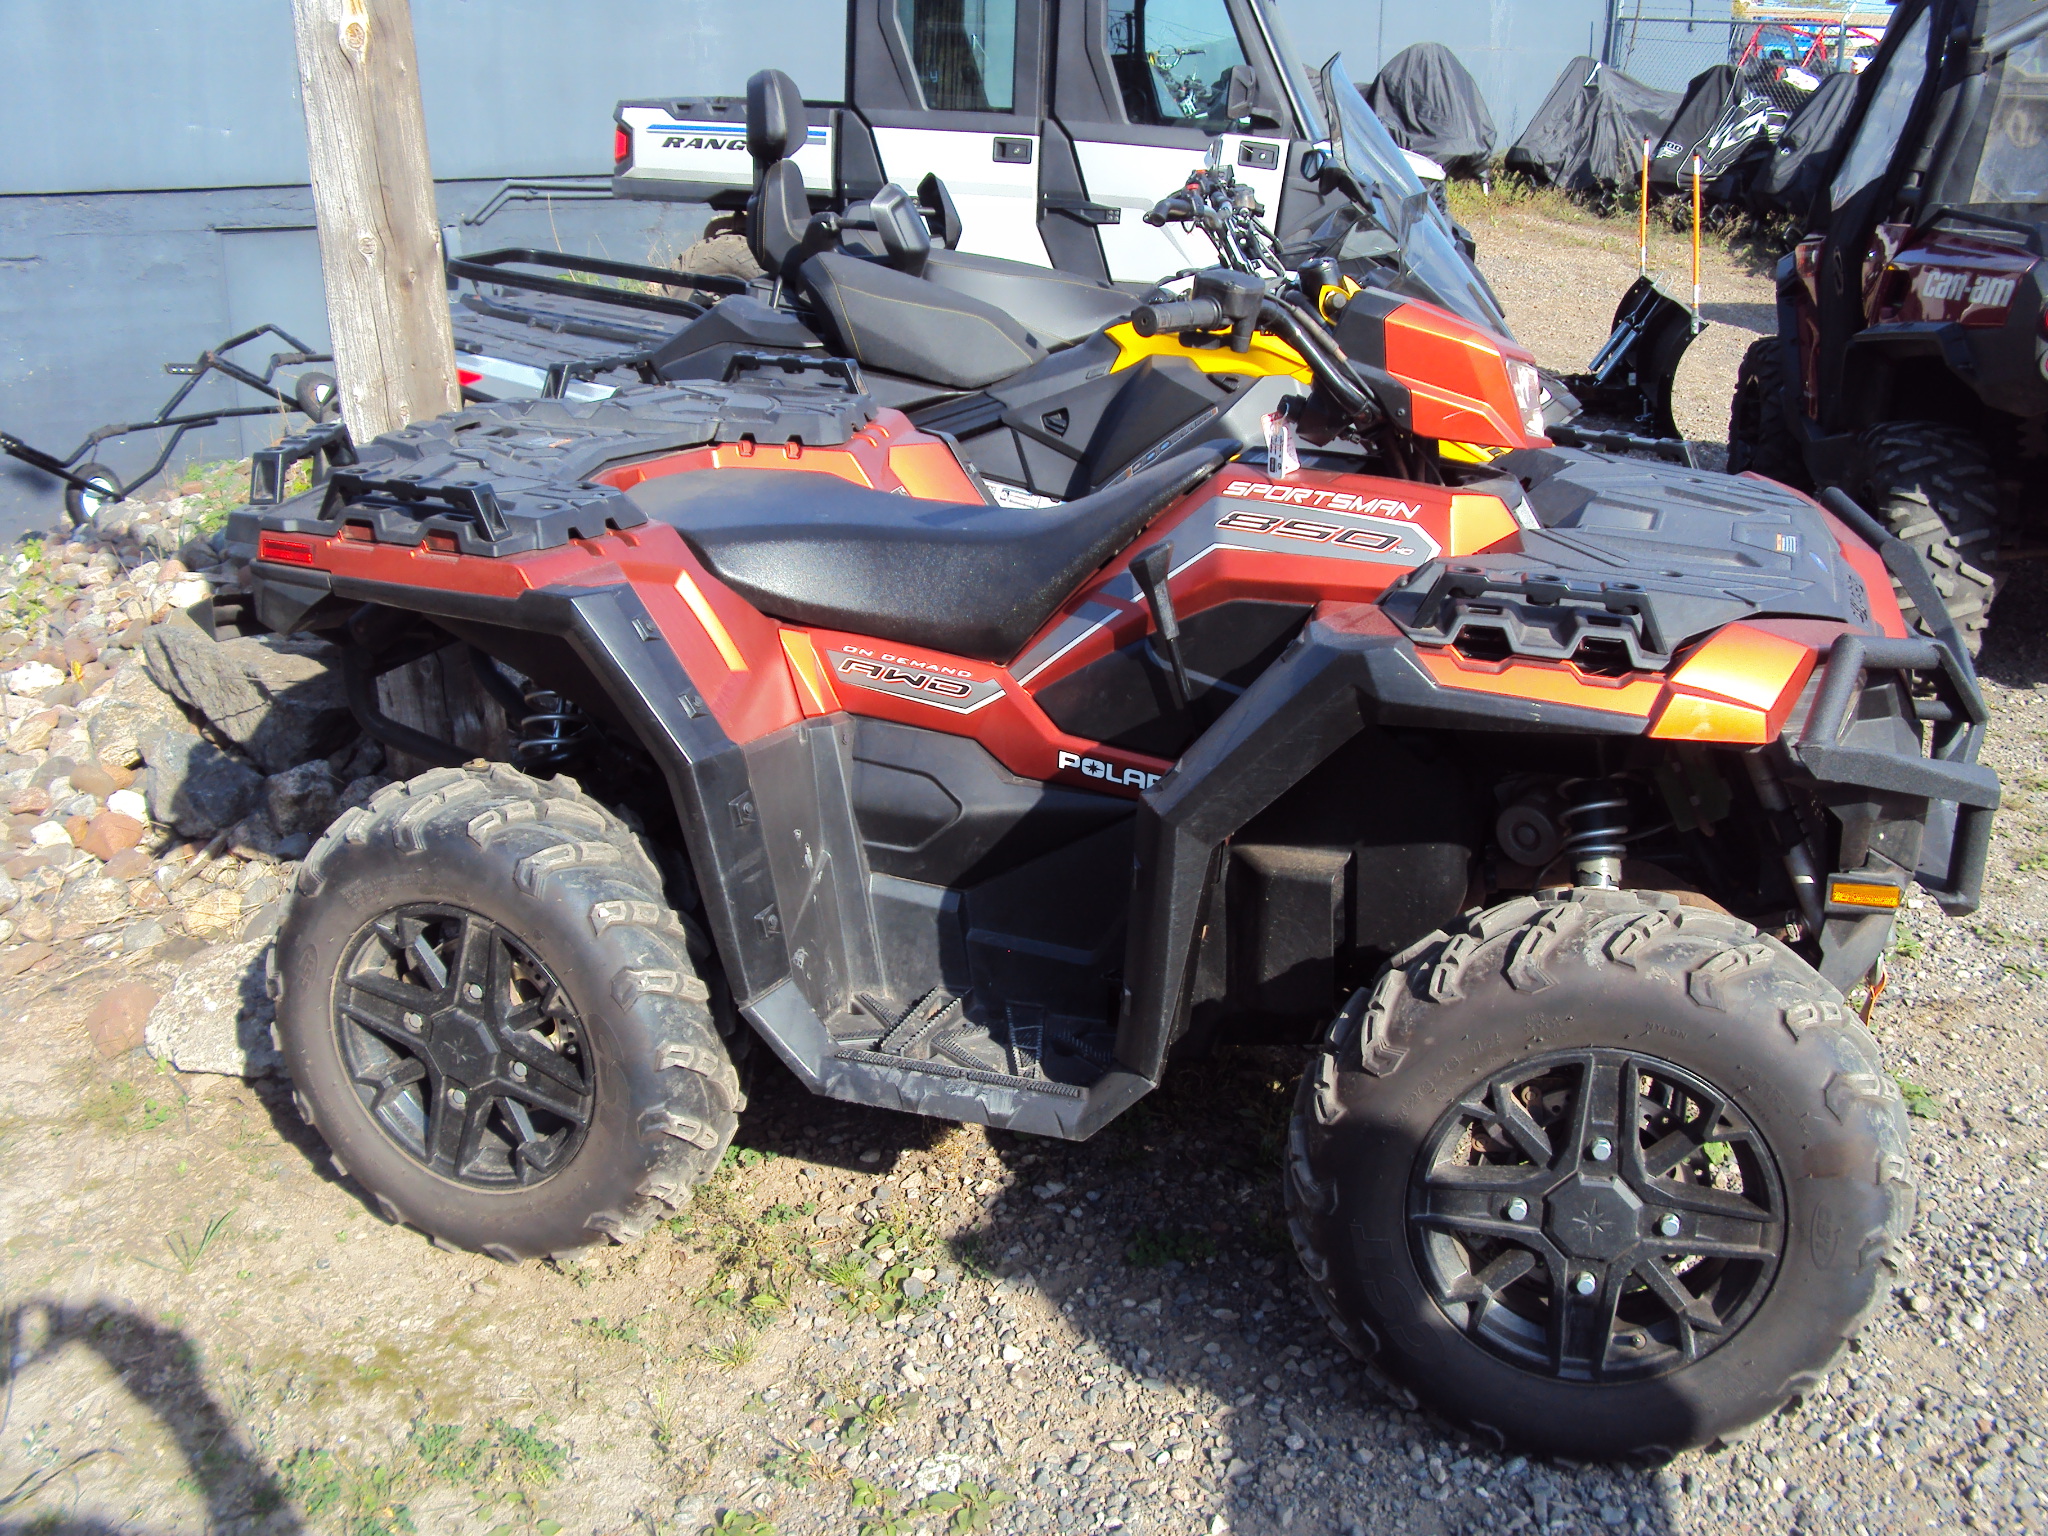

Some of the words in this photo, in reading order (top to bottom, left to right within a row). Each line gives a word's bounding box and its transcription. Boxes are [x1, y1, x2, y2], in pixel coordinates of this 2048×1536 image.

[1222, 480, 1422, 520] SPORTSMAN
[1214, 510, 1402, 552] 850
[837, 657, 973, 698] AWD
[842, 645, 875, 657] ON
[880, 653, 973, 678] DEMAND
